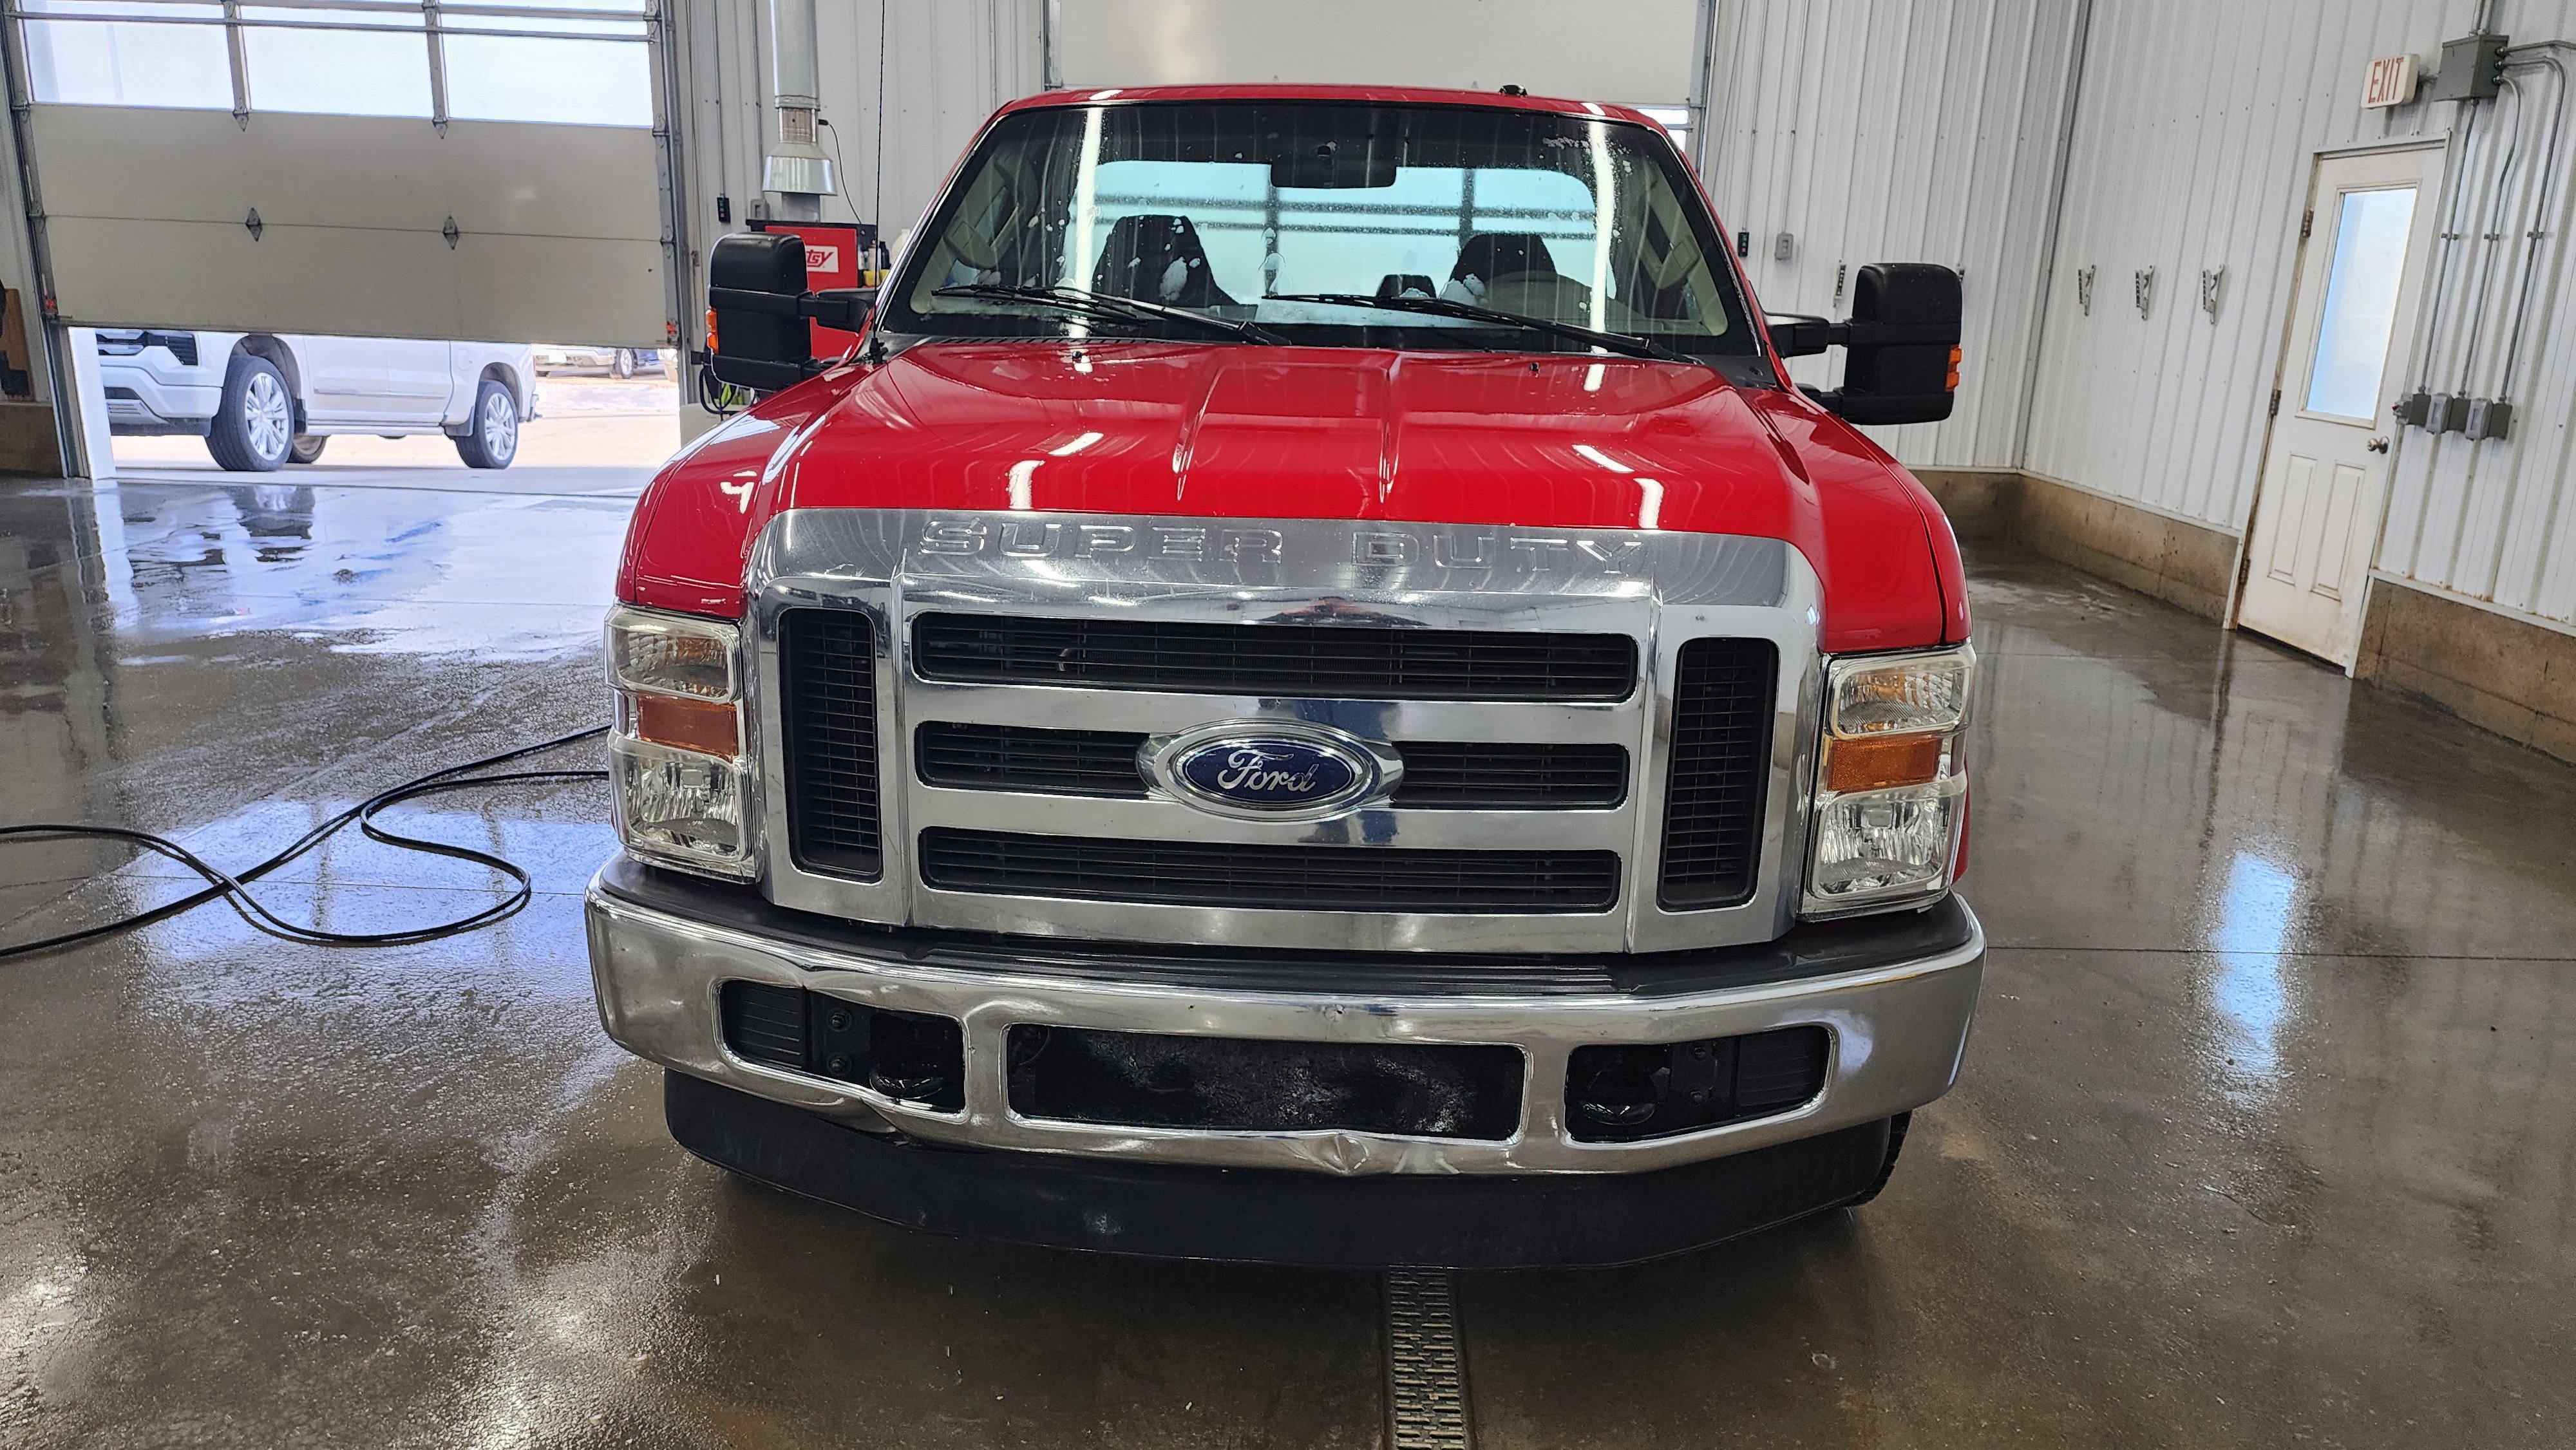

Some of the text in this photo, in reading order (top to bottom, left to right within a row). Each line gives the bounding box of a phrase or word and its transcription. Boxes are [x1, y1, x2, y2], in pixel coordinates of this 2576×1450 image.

[2368, 56, 2405, 104] EXIT
[806, 249, 834, 267] tsy
[918, 518, 1643, 575] SUPER DUTY
[1217, 749, 1320, 793] Ford
